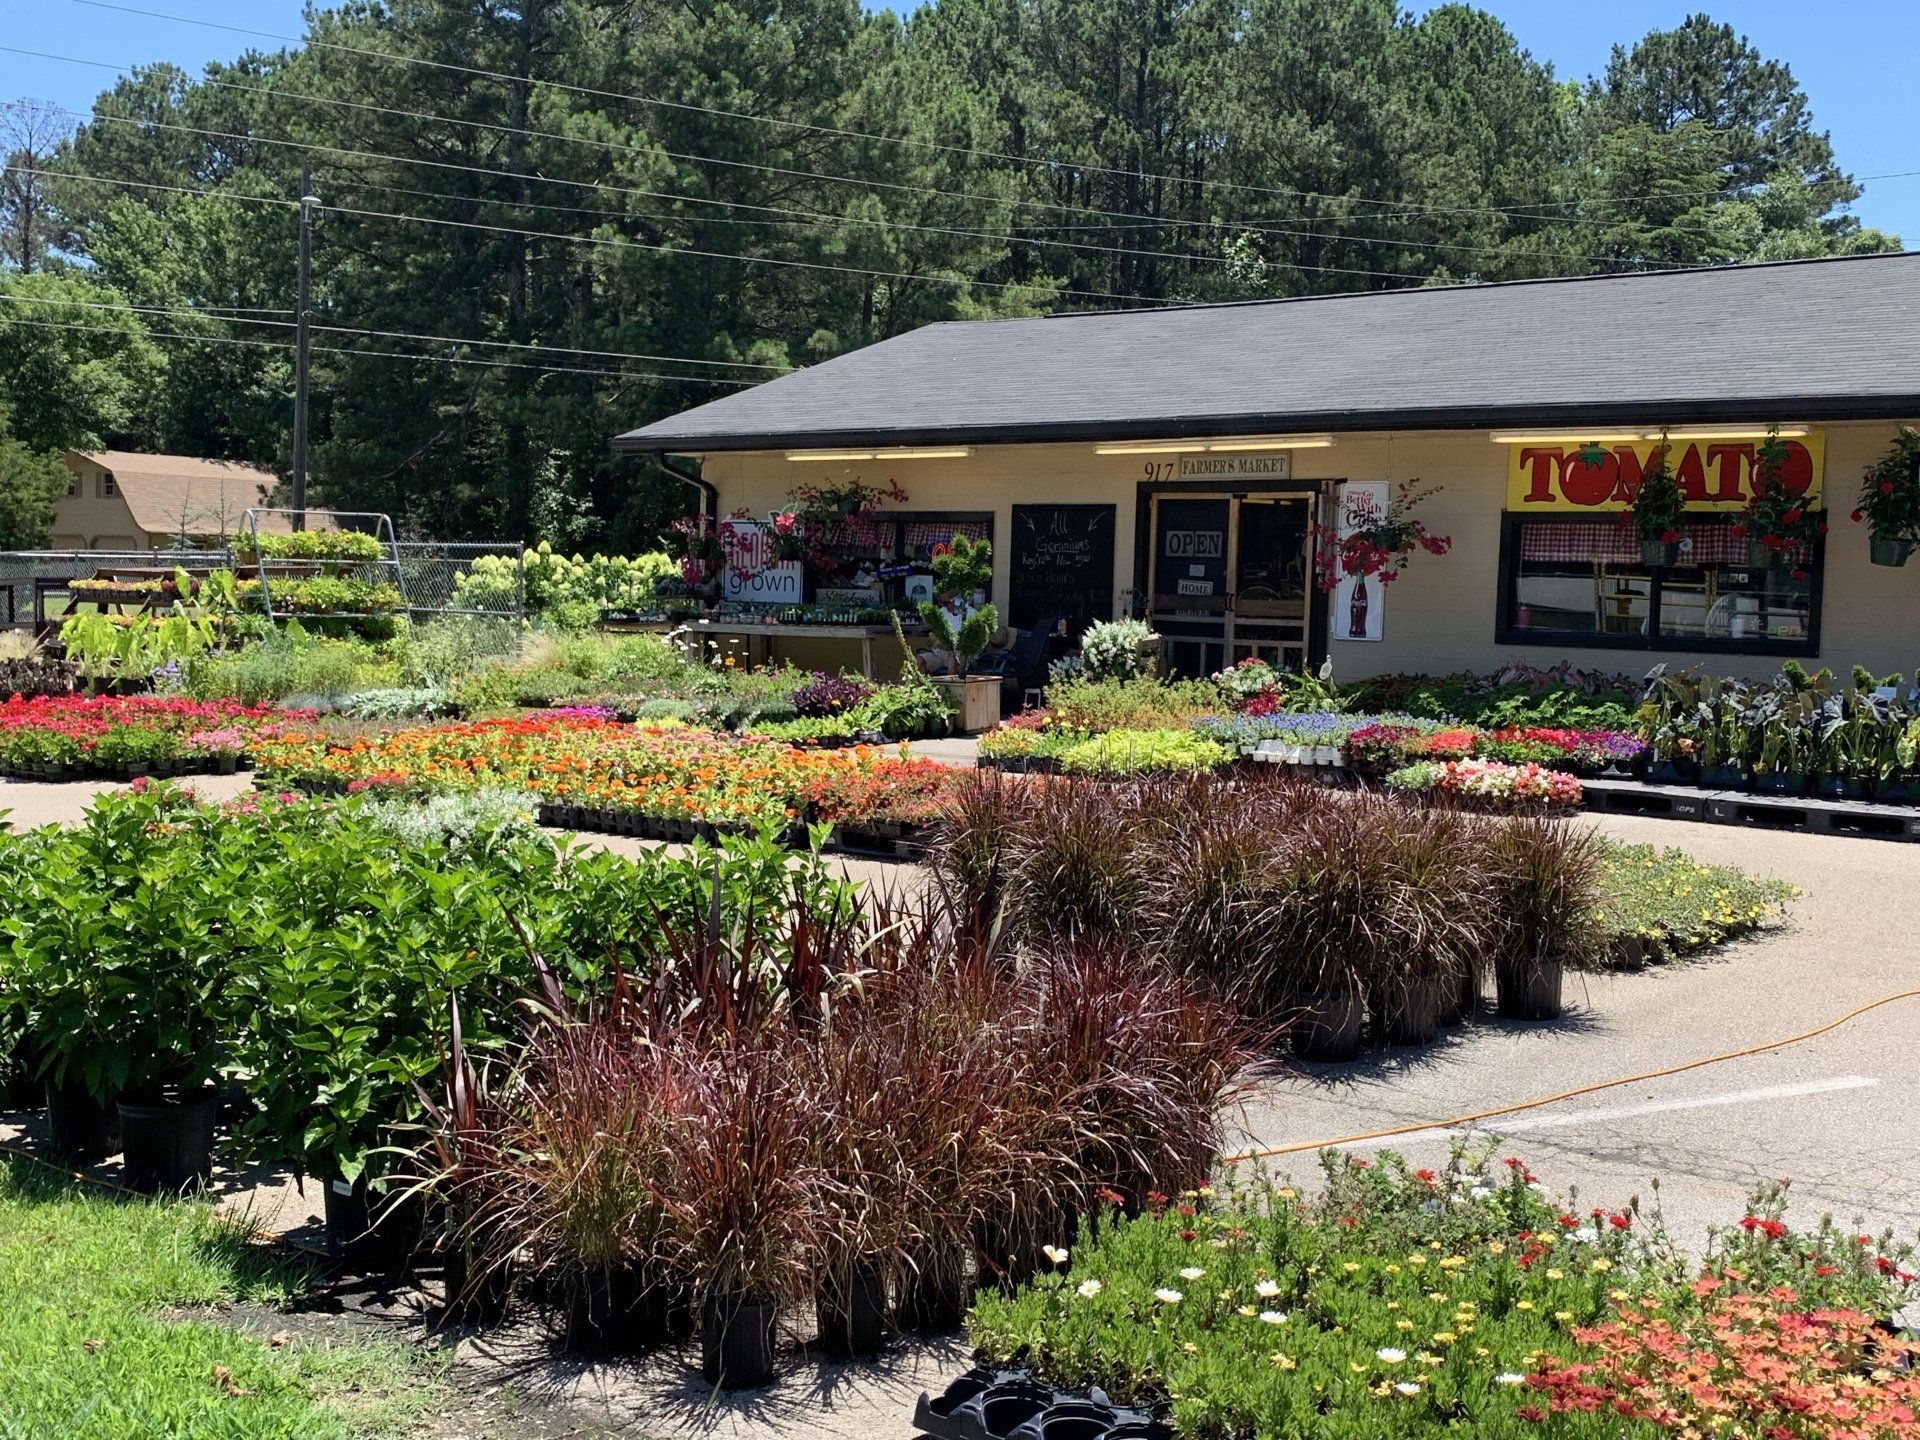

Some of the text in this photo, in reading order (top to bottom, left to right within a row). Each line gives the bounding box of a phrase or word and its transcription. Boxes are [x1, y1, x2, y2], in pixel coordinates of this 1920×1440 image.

[1145, 462, 1174, 481] 917
[1182, 457, 1286, 474] FARMER'S MARKET
[1520, 440, 1813, 505] TOMATO
[1346, 495, 1373, 505] Better
[1049, 511, 1068, 536] All
[1036, 536, 1090, 552] Geraniums
[1169, 533, 1220, 554] OPEN
[731, 573, 795, 595] grown
[1181, 583, 1210, 595] HOME
